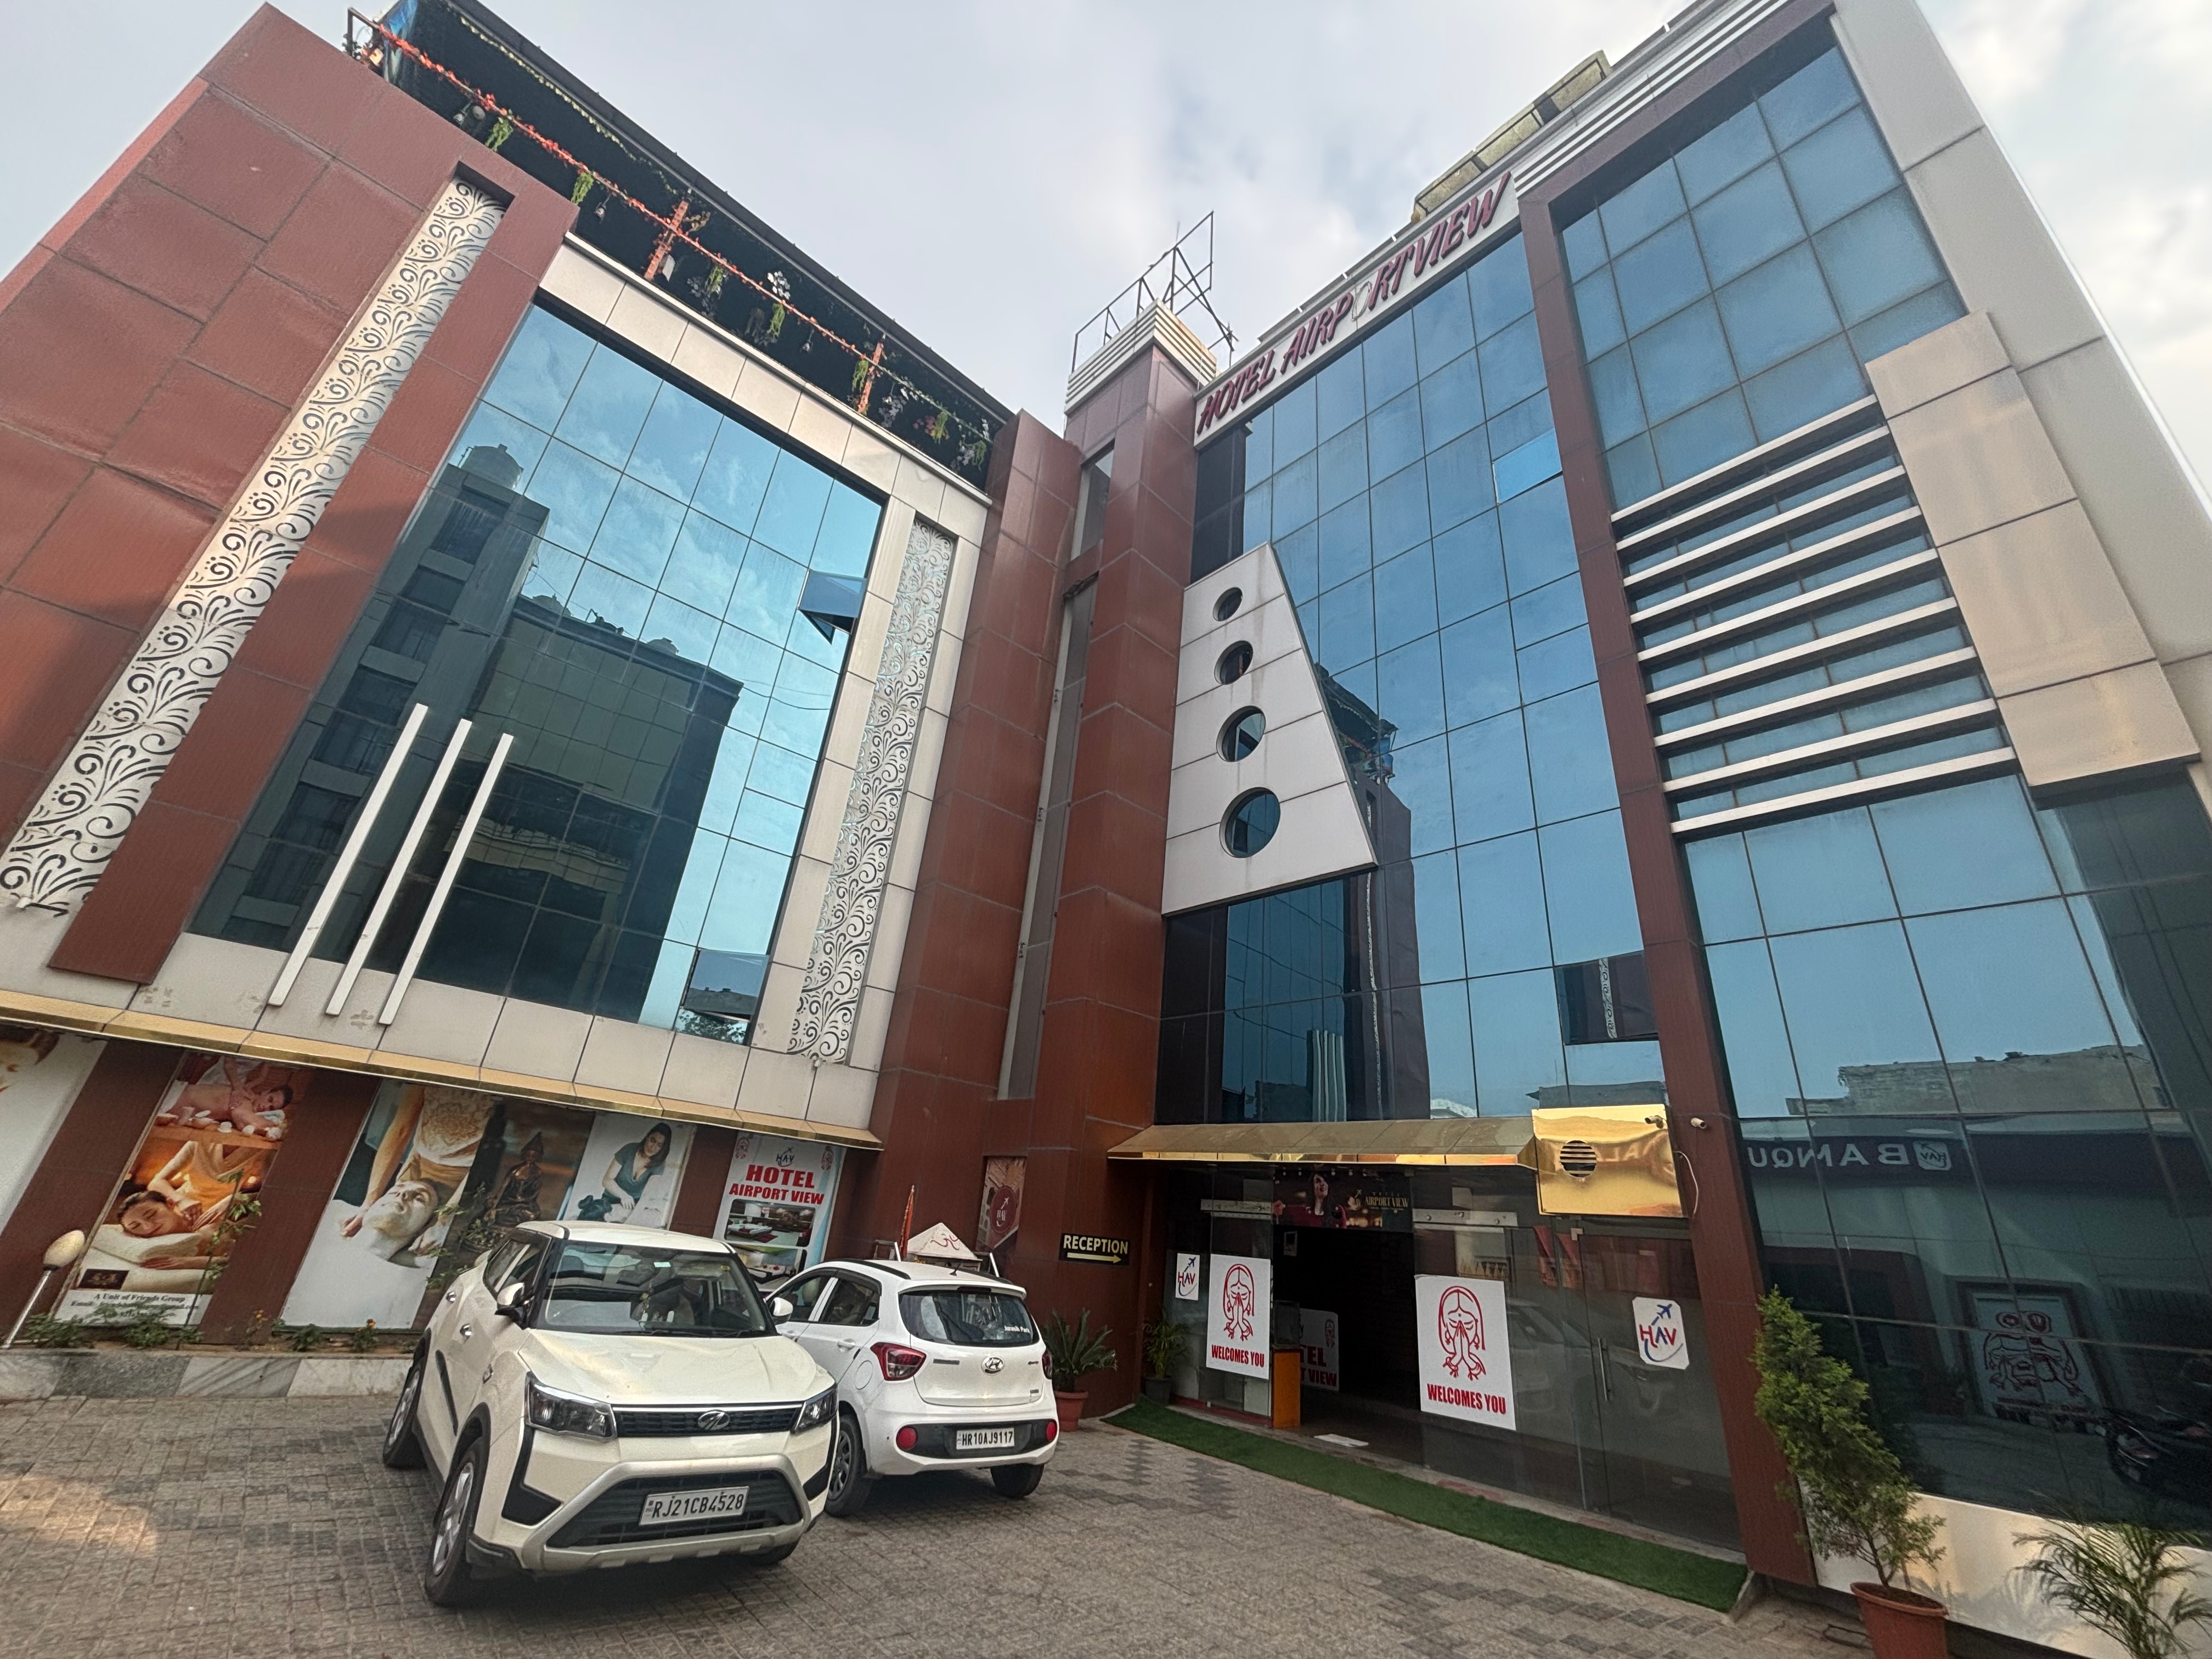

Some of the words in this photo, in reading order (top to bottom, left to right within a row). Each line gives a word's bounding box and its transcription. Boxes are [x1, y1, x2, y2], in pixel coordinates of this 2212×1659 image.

[1197, 349, 1276, 435] HOTEL
[1414, 171, 1512, 278] VIEW
[745, 1164, 815, 1189] HOTEL
[729, 1183, 789, 1201] AIRPORT
[791, 1189, 825, 1205] VIEW
[1364, 1196, 1390, 1206] AIRPORT
[1391, 1197, 1409, 1207] VIEW
[1063, 1234, 1128, 1255] RECEPTION
[1178, 1271, 1196, 1287] HAV
[161, 1295, 186, 1303] Group
[1639, 1323, 1677, 1348] HAV
[1211, 1344, 1249, 1365] WELCOMES
[1250, 1351, 1265, 1368] YOU
[1308, 1368, 1337, 1387] VIEW
[1426, 1383, 1483, 1410] WELCOMES
[1483, 1393, 1506, 1415] YOU
[962, 1431, 1014, 1446] HR10AJ9117
[652, 1493, 744, 1519] RJ21CB4528
